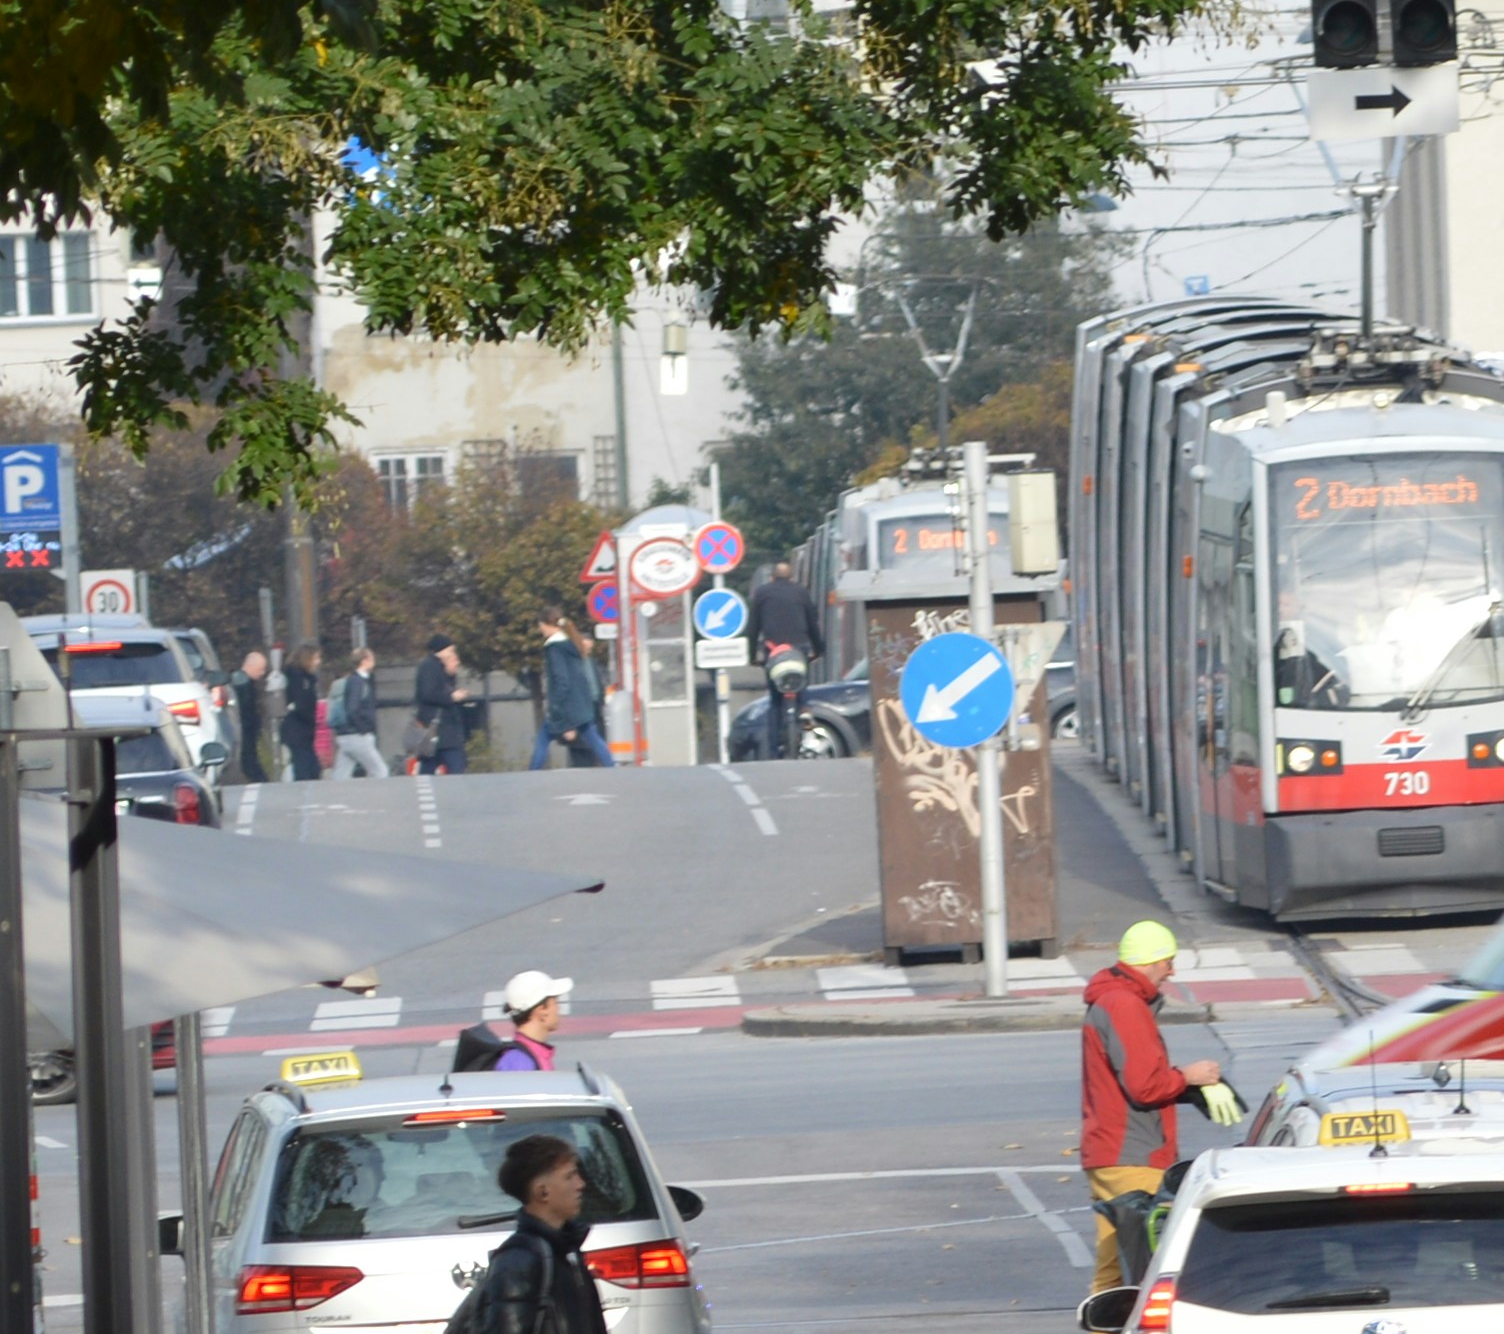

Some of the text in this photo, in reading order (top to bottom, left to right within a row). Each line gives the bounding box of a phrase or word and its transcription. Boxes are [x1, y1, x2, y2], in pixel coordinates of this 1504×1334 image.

[4, 465, 45, 514] P
[1294, 474, 1478, 520] 2 Dornbach
[97, 590, 119, 613] 30
[1384, 770, 1430, 796] 730
[292, 1057, 348, 1076] TAXI
[1332, 1115, 1394, 1137] TAXI
